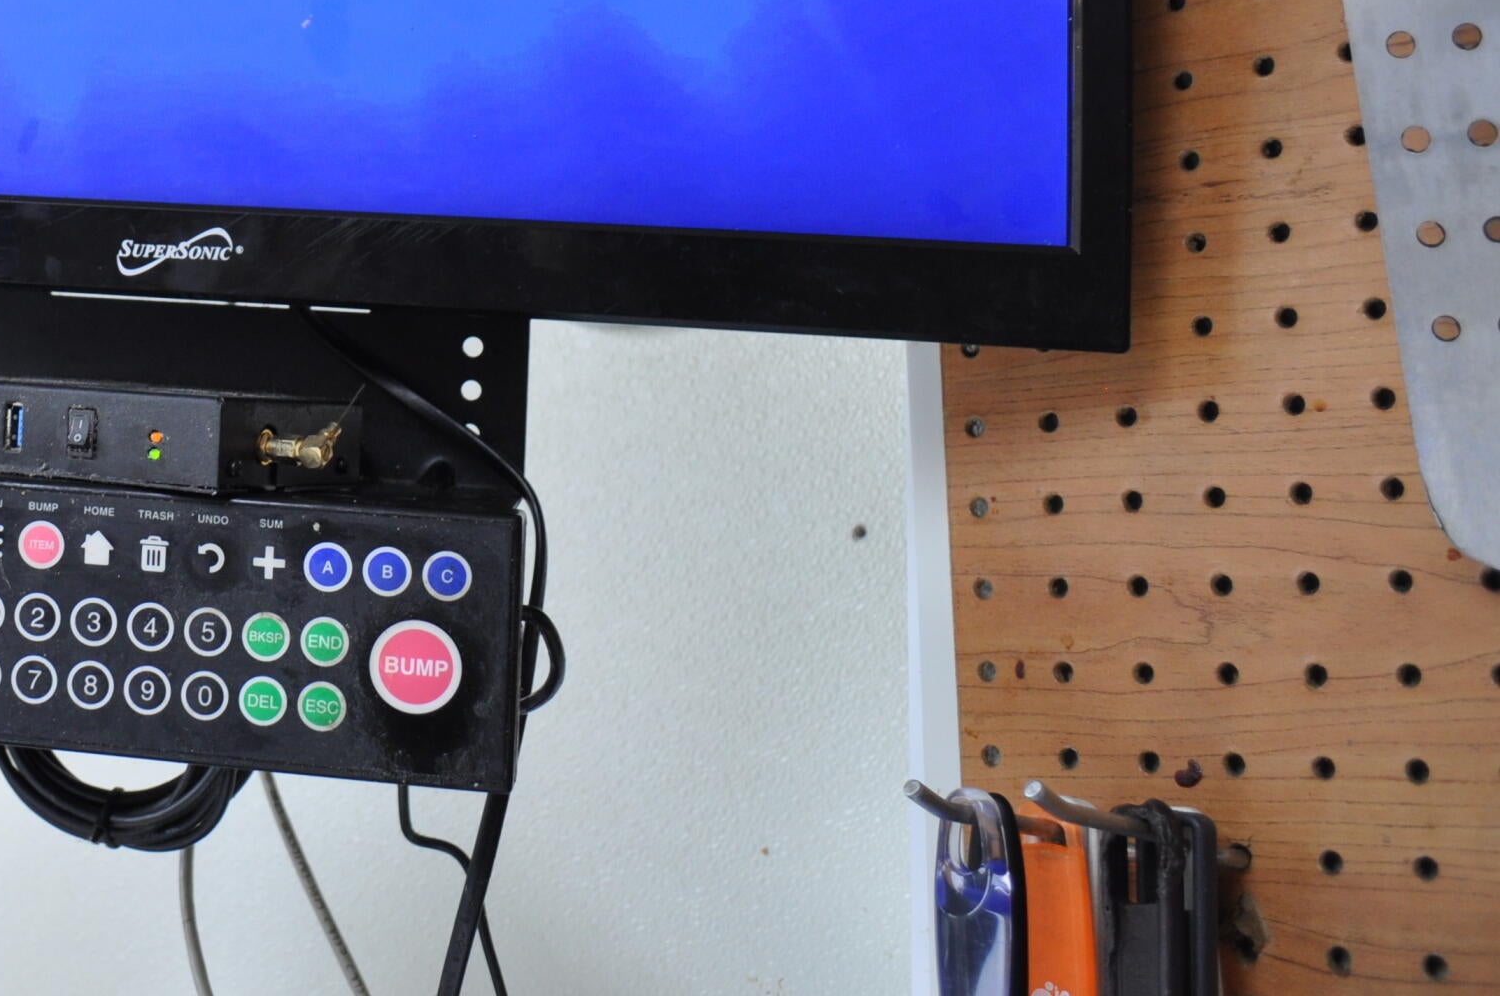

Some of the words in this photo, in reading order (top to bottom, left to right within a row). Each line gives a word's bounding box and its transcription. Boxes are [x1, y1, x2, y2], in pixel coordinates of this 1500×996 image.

[28, 501, 59, 512] BUMP
[83, 506, 115, 517] HOME
[138, 509, 175, 521] TRASH
[197, 514, 229, 525] UNDO
[259, 518, 284, 529] SUM
[29, 539, 55, 551] ITEM
[321, 560, 334, 575] A
[381, 564, 393, 579] B
[441, 568, 454, 584] C
[30, 607, 45, 628] 2
[86, 611, 101, 633] 3
[143, 617, 158, 638] 4
[201, 621, 216, 643] 5
[248, 629, 284, 644] BKSP
[307, 634, 343, 650] END
[384, 656, 449, 678] BUMP
[27, 669, 42, 690] 7
[83, 674, 98, 696] 8
[140, 680, 156, 701] 9
[197, 685, 213, 707] 0
[247, 693, 278, 709] DEL
[304, 698, 340, 716] ESC
